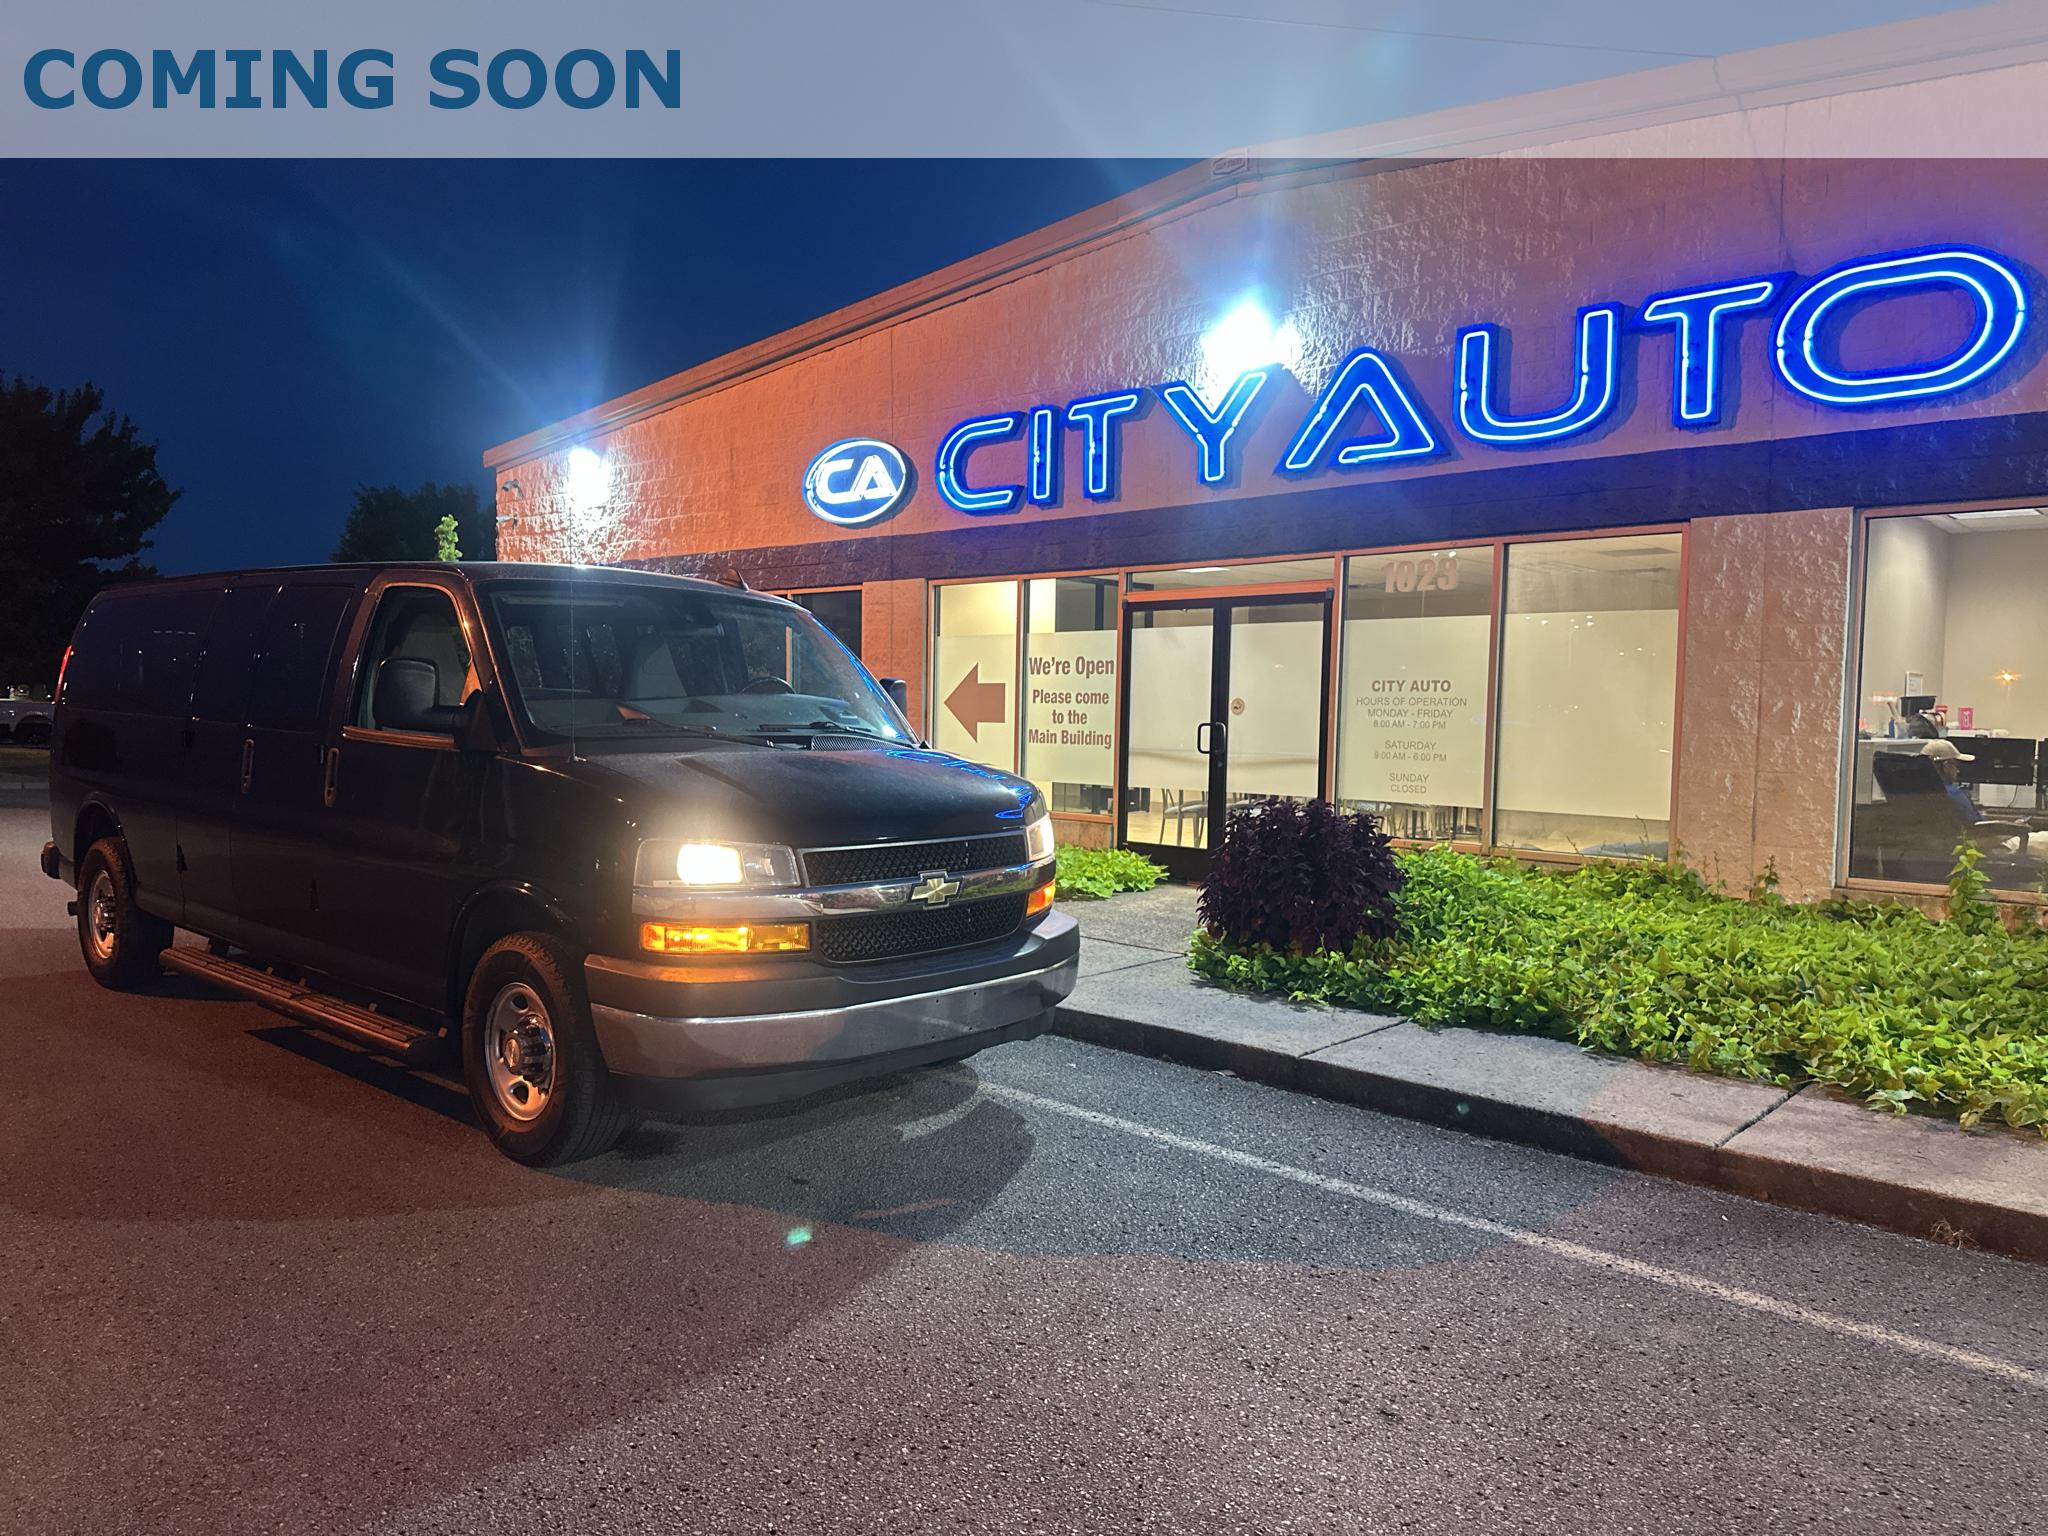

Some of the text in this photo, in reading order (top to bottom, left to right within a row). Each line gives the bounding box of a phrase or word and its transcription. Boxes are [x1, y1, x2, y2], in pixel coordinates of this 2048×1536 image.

[935, 243, 2031, 513] CITY AUTO
[815, 454, 899, 505] CA
[1029, 656, 1115, 679] We're Open
[1371, 680, 1452, 693] CITY AUTO
[1032, 689, 1109, 704] Please come
[1356, 697, 1468, 707] HOURS OF OPERATION
[1051, 709, 1088, 725] to the
[1367, 708, 1409, 718] MONDAY
[1417, 709, 1454, 719] FRIDAY
[1391, 720, 1405, 728] AM
[1432, 721, 1447, 729] PM
[1028, 729, 1112, 749] Main Building
[1384, 740, 1437, 750] SATURDAY
[1392, 751, 1406, 761] AM
[1433, 753, 1448, 761] PM
[1389, 773, 1430, 783] SUNDAY
[1390, 784, 1427, 794] CLOSED
